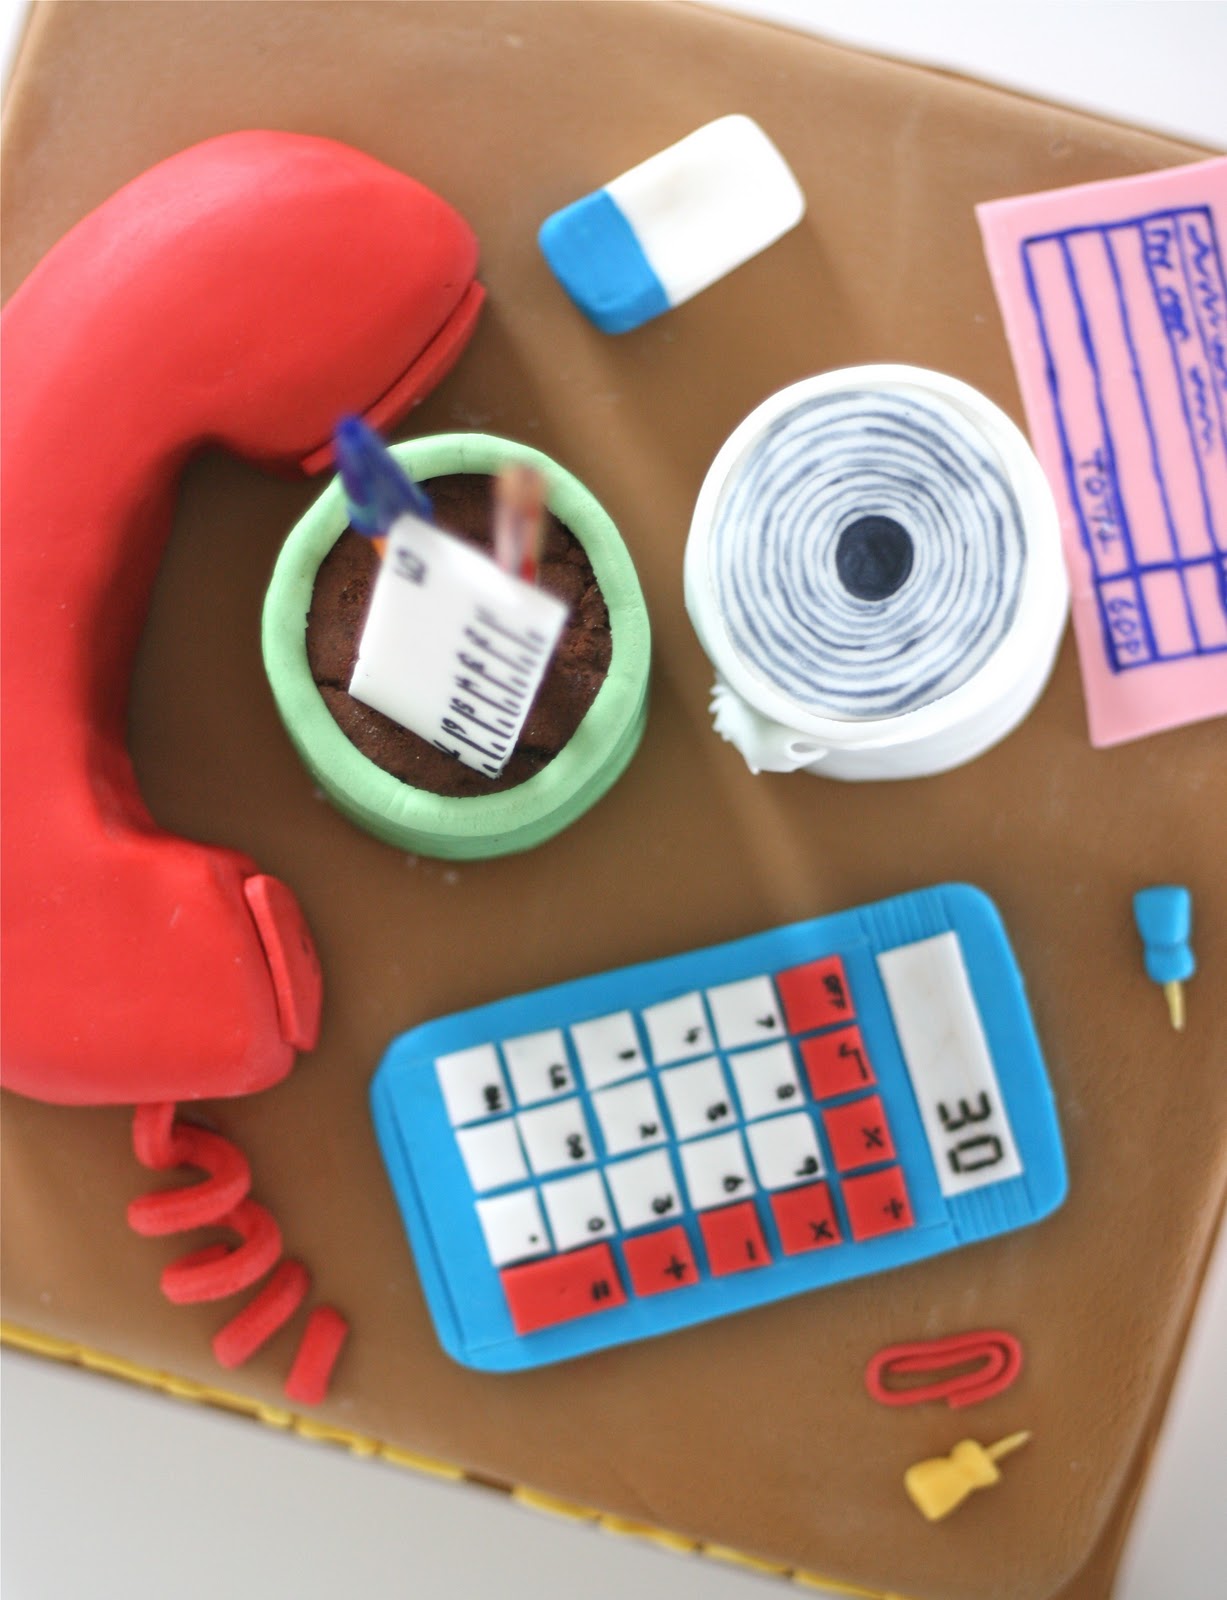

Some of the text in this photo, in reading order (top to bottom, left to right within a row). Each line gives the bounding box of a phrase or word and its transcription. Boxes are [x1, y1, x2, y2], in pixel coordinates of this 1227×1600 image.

[822, 974, 845, 1009] OFF
[756, 1014, 775, 1028] 7
[685, 1027, 702, 1044] 4
[777, 1084, 795, 1099] 8
[707, 1102, 728, 1122] 5
[639, 1123, 657, 1139] 2
[936, 1091, 1004, 1174] 30
[795, 1156, 818, 1177] 9
[723, 1175, 744, 1192] 6
[652, 1195, 673, 1214] 3
